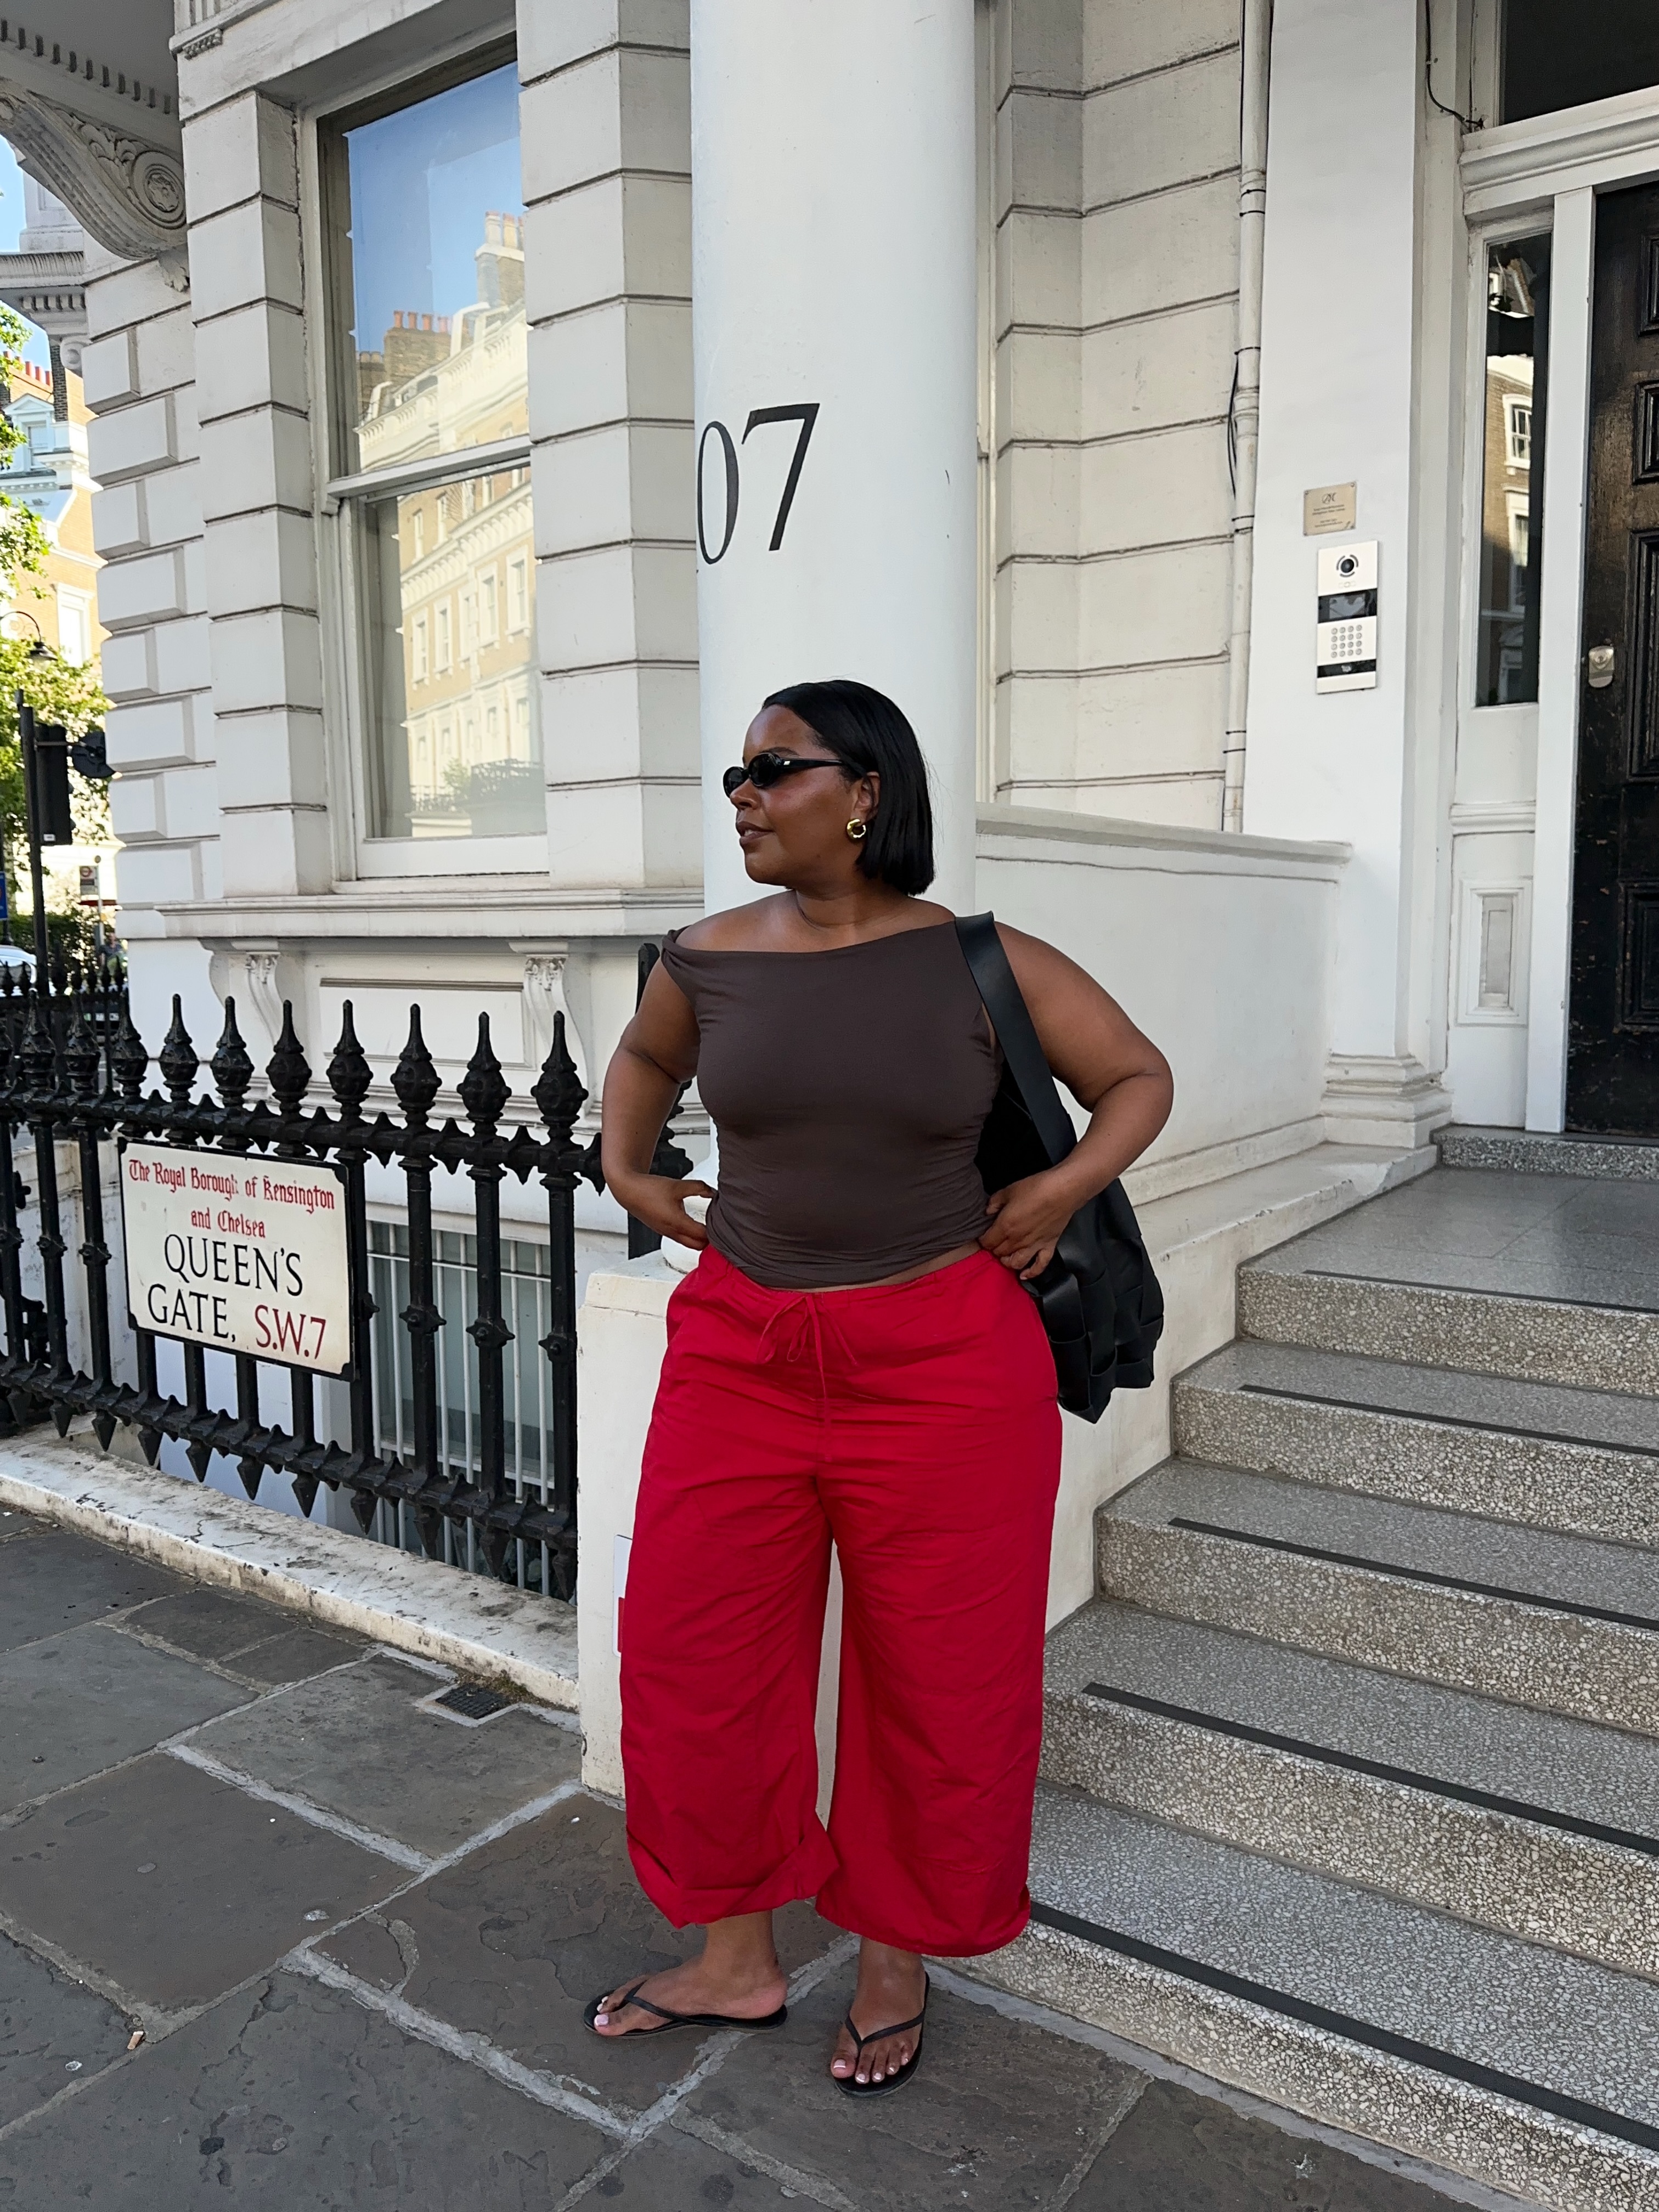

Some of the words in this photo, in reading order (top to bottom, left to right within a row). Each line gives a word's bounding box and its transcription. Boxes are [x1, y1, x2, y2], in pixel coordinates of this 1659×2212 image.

[129, 1159, 151, 1182] The
[153, 1161, 185, 1193] Royal
[191, 1167, 239, 1201] Borough
[245, 1176, 259, 1198] of
[263, 1175, 335, 1215] Kensington
[190, 1206, 211, 1230] and
[217, 1210, 266, 1238] Chelsea
[164, 1234, 303, 1297] QUEEN'S
[147, 1283, 236, 1342] GATE,
[254, 1304, 327, 1360] S.W.7
